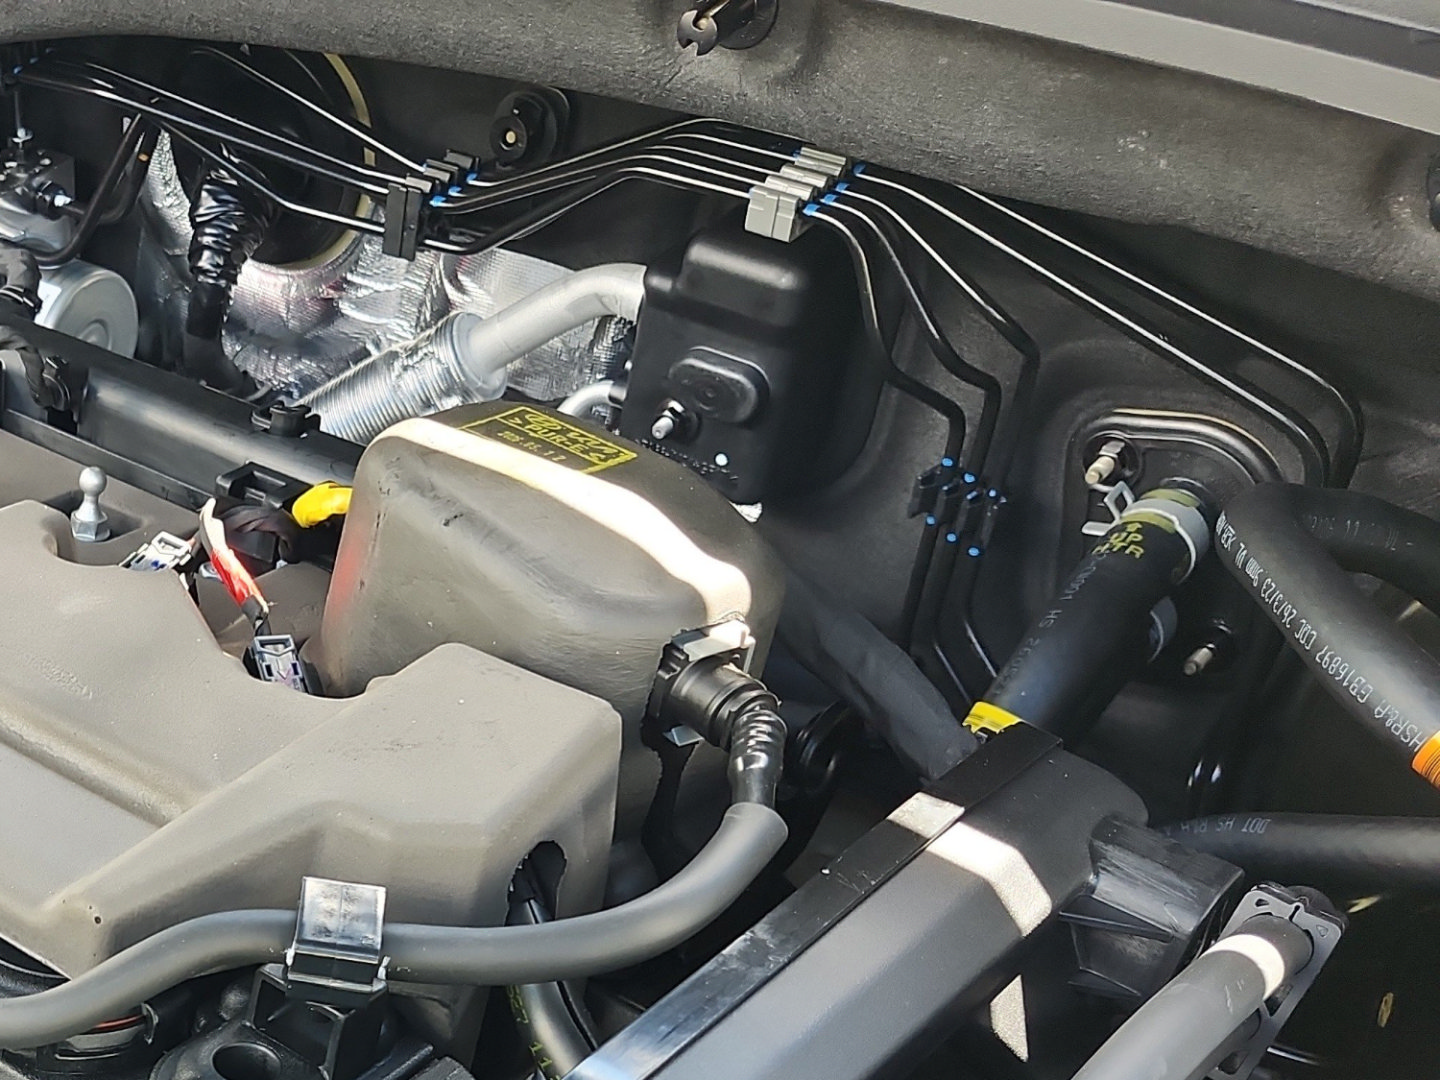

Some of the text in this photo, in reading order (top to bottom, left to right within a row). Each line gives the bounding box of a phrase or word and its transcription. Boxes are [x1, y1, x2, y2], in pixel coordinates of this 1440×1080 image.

[1109, 531, 1143, 545] UP
[1315, 644, 1374, 704] GB16897
[1374, 699, 1426, 754] HSR&A
